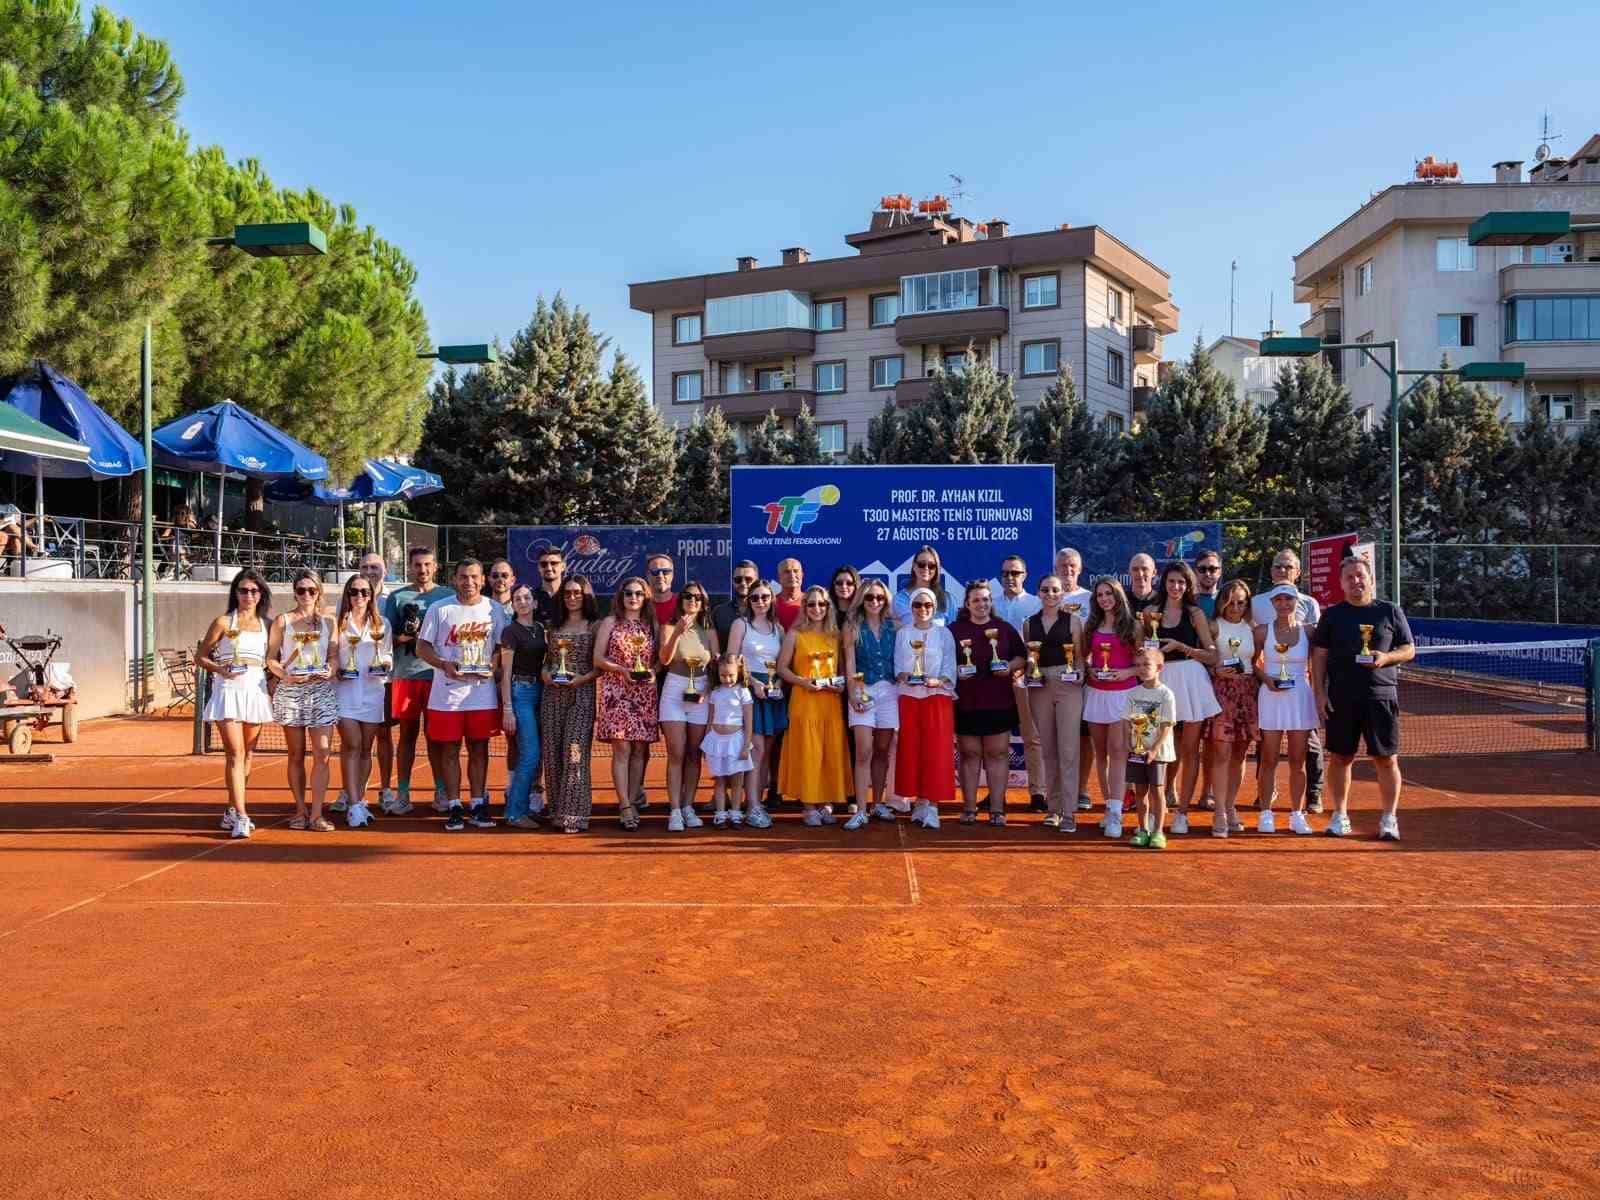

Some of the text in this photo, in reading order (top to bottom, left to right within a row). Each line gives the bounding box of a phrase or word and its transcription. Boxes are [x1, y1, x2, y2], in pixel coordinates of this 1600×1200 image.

[891, 489, 1005, 503] PROF. DR. AYHAN KIZIL
[863, 506, 1033, 522] T300 MASTERS TENİS TURNUVASI
[792, 537, 842, 545] FEDERASYONU
[877, 527, 890, 541] 27
[892, 525, 939, 541] AĞUSTOS
[947, 527, 955, 541] 6
[957, 525, 990, 541] EYLÜL
[991, 527, 1019, 541] 2026
[677, 539, 713, 557] PROF.
